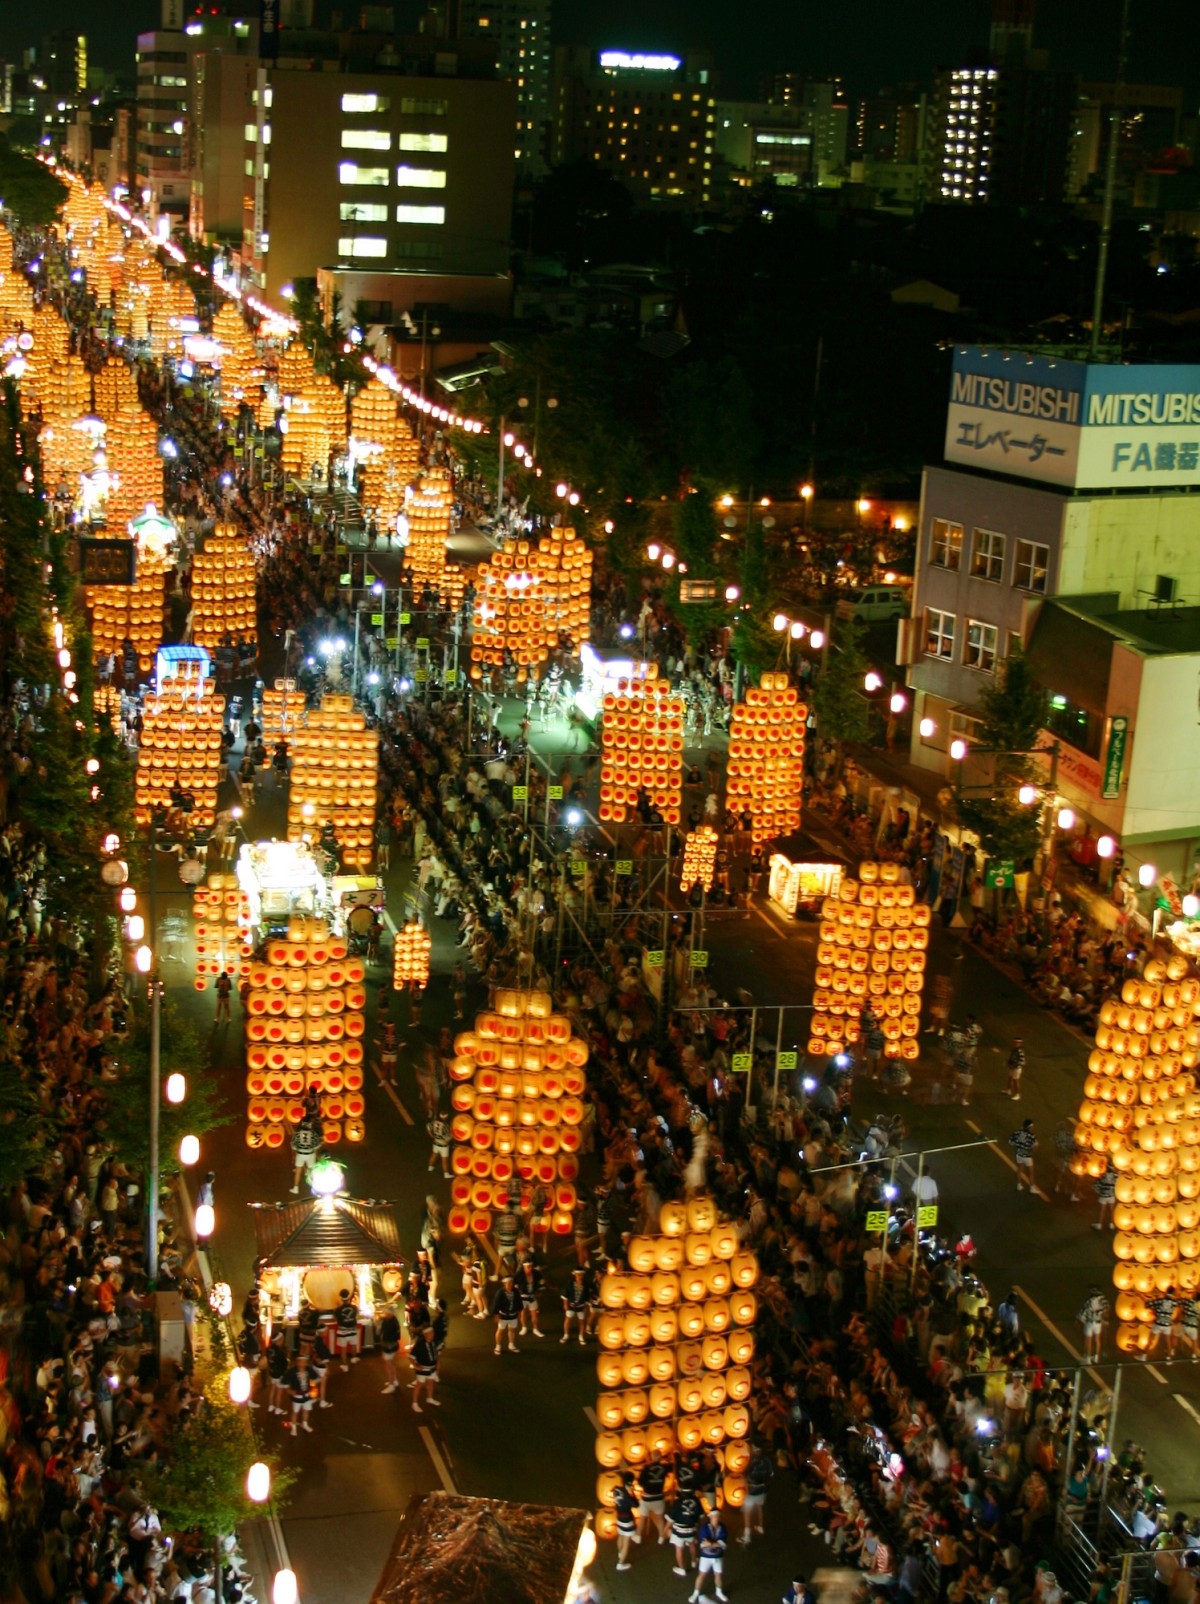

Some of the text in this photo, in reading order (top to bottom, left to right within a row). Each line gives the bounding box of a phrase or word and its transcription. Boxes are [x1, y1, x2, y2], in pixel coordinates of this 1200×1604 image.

[952, 371, 1080, 424] MITSUBISHI
[956, 420, 1066, 462] エレベーター
[513, 787, 526, 796] 33
[549, 787, 562, 795] 34
[572, 862, 586, 871] 31
[617, 862, 631, 870] 32
[648, 952, 663, 962] 29
[691, 952, 706, 962] 30
[734, 1055, 749, 1066] 27
[778, 1053, 795, 1064] 28
[868, 1213, 886, 1225] 25
[919, 1208, 935, 1221] 26
